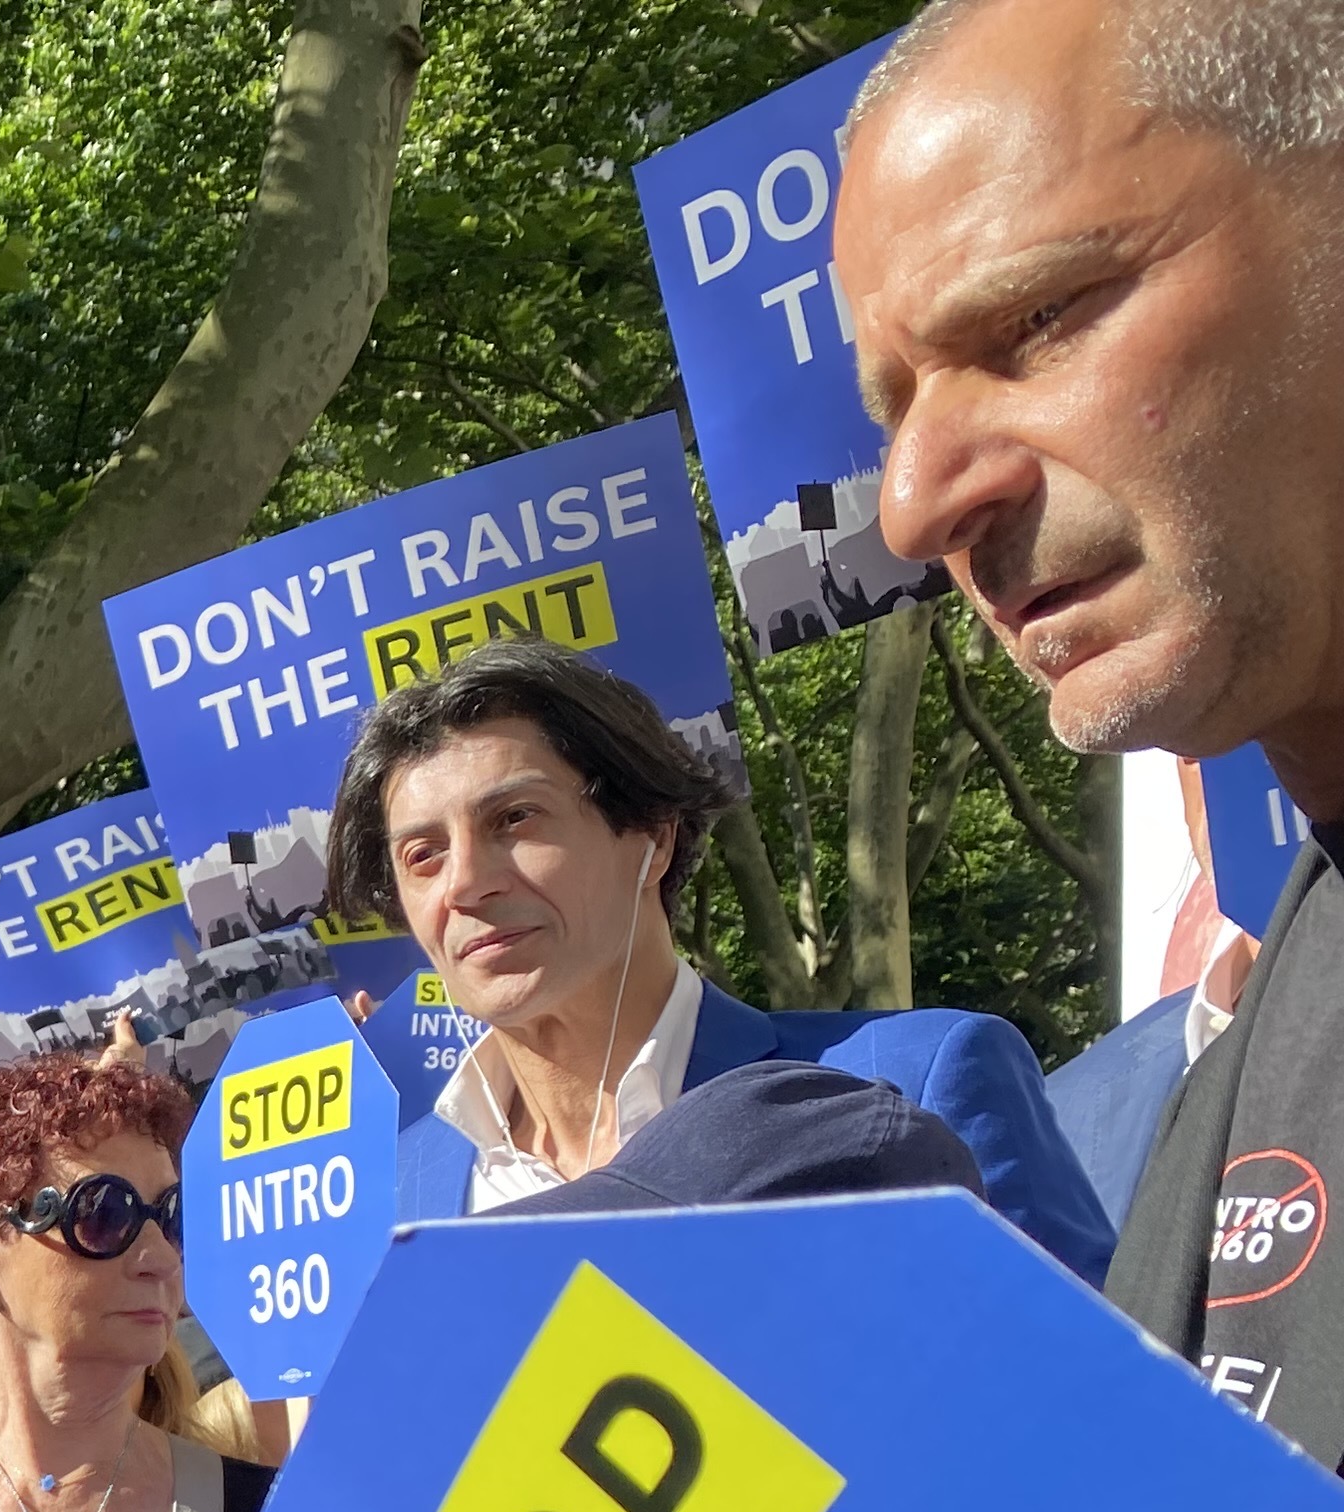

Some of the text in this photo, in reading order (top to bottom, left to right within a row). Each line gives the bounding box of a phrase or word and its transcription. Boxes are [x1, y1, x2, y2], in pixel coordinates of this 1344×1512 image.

[138, 467, 657, 690] DON'T RAISE
[198, 574, 594, 751] THE RENT
[55, 813, 169, 882] RAI
[229, 1065, 344, 1149] STOP
[220, 1154, 355, 1242] INTRO
[1214, 1196, 1316, 1233] NTRO
[248, 1253, 330, 1324] 360
